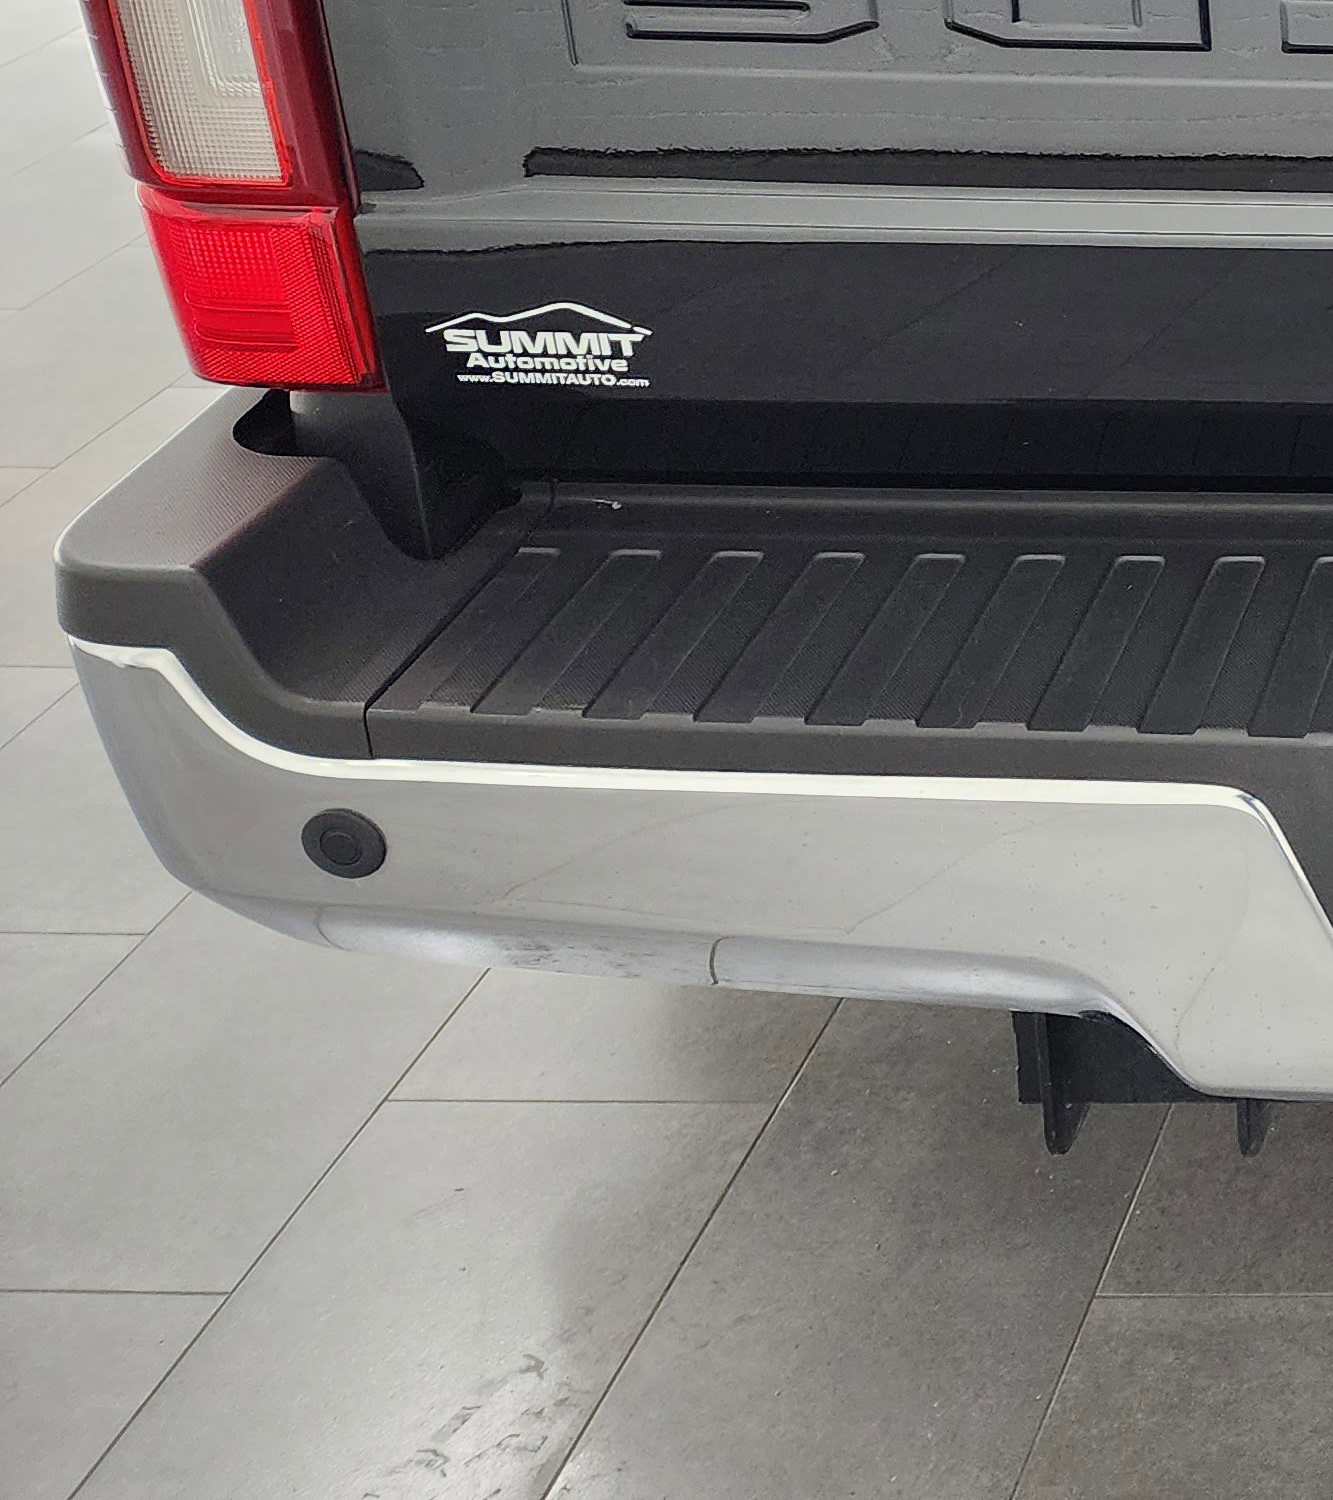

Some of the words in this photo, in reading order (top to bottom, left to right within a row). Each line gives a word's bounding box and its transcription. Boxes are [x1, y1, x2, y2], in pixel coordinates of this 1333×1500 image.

[443, 328, 645, 357] SUMMIT
[466, 353, 629, 372] Automotive
[457, 371, 650, 387] www.SUMMITAUTO.com
